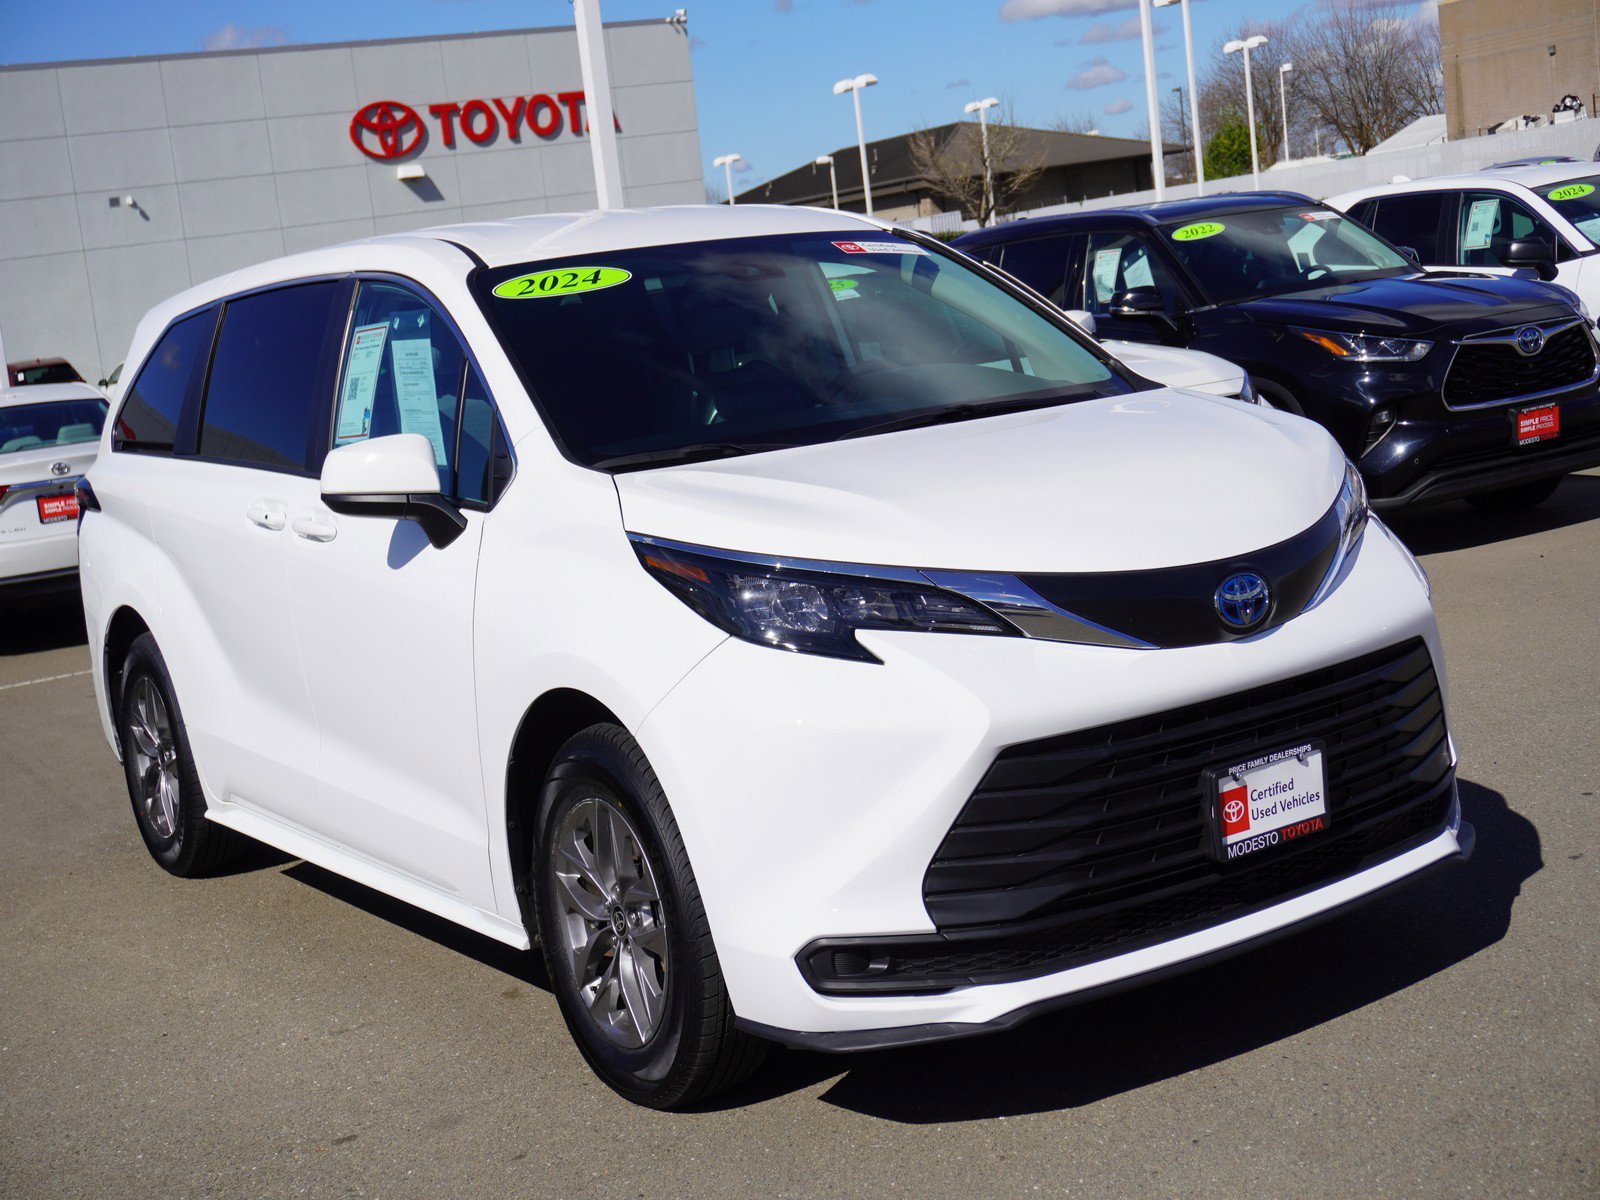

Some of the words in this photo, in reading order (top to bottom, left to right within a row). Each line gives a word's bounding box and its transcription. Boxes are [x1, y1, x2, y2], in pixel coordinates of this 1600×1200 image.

[429, 90, 619, 146] TOYOT
[1555, 185, 1585, 199] 2024
[1183, 224, 1215, 239] 2022
[517, 269, 602, 296] 2024
[1520, 417, 1539, 427] SIMPLE
[1539, 414, 1554, 424] PRICE
[1520, 425, 1536, 433] SIMPLE
[1519, 436, 1540, 446] MODESTO
[44, 500, 65, 509] SIMPLE
[1228, 764, 1247, 775] PRICE
[1247, 756, 1269, 769] FAMILY
[1269, 744, 1312, 762] DEALERSHIPS
[1250, 778, 1294, 802] Certified
[1251, 802, 1278, 820] Used
[1279, 791, 1320, 812] Vehicles
[1227, 831, 1279, 859] MODESTO
[1280, 818, 1324, 840] TOYOTA
